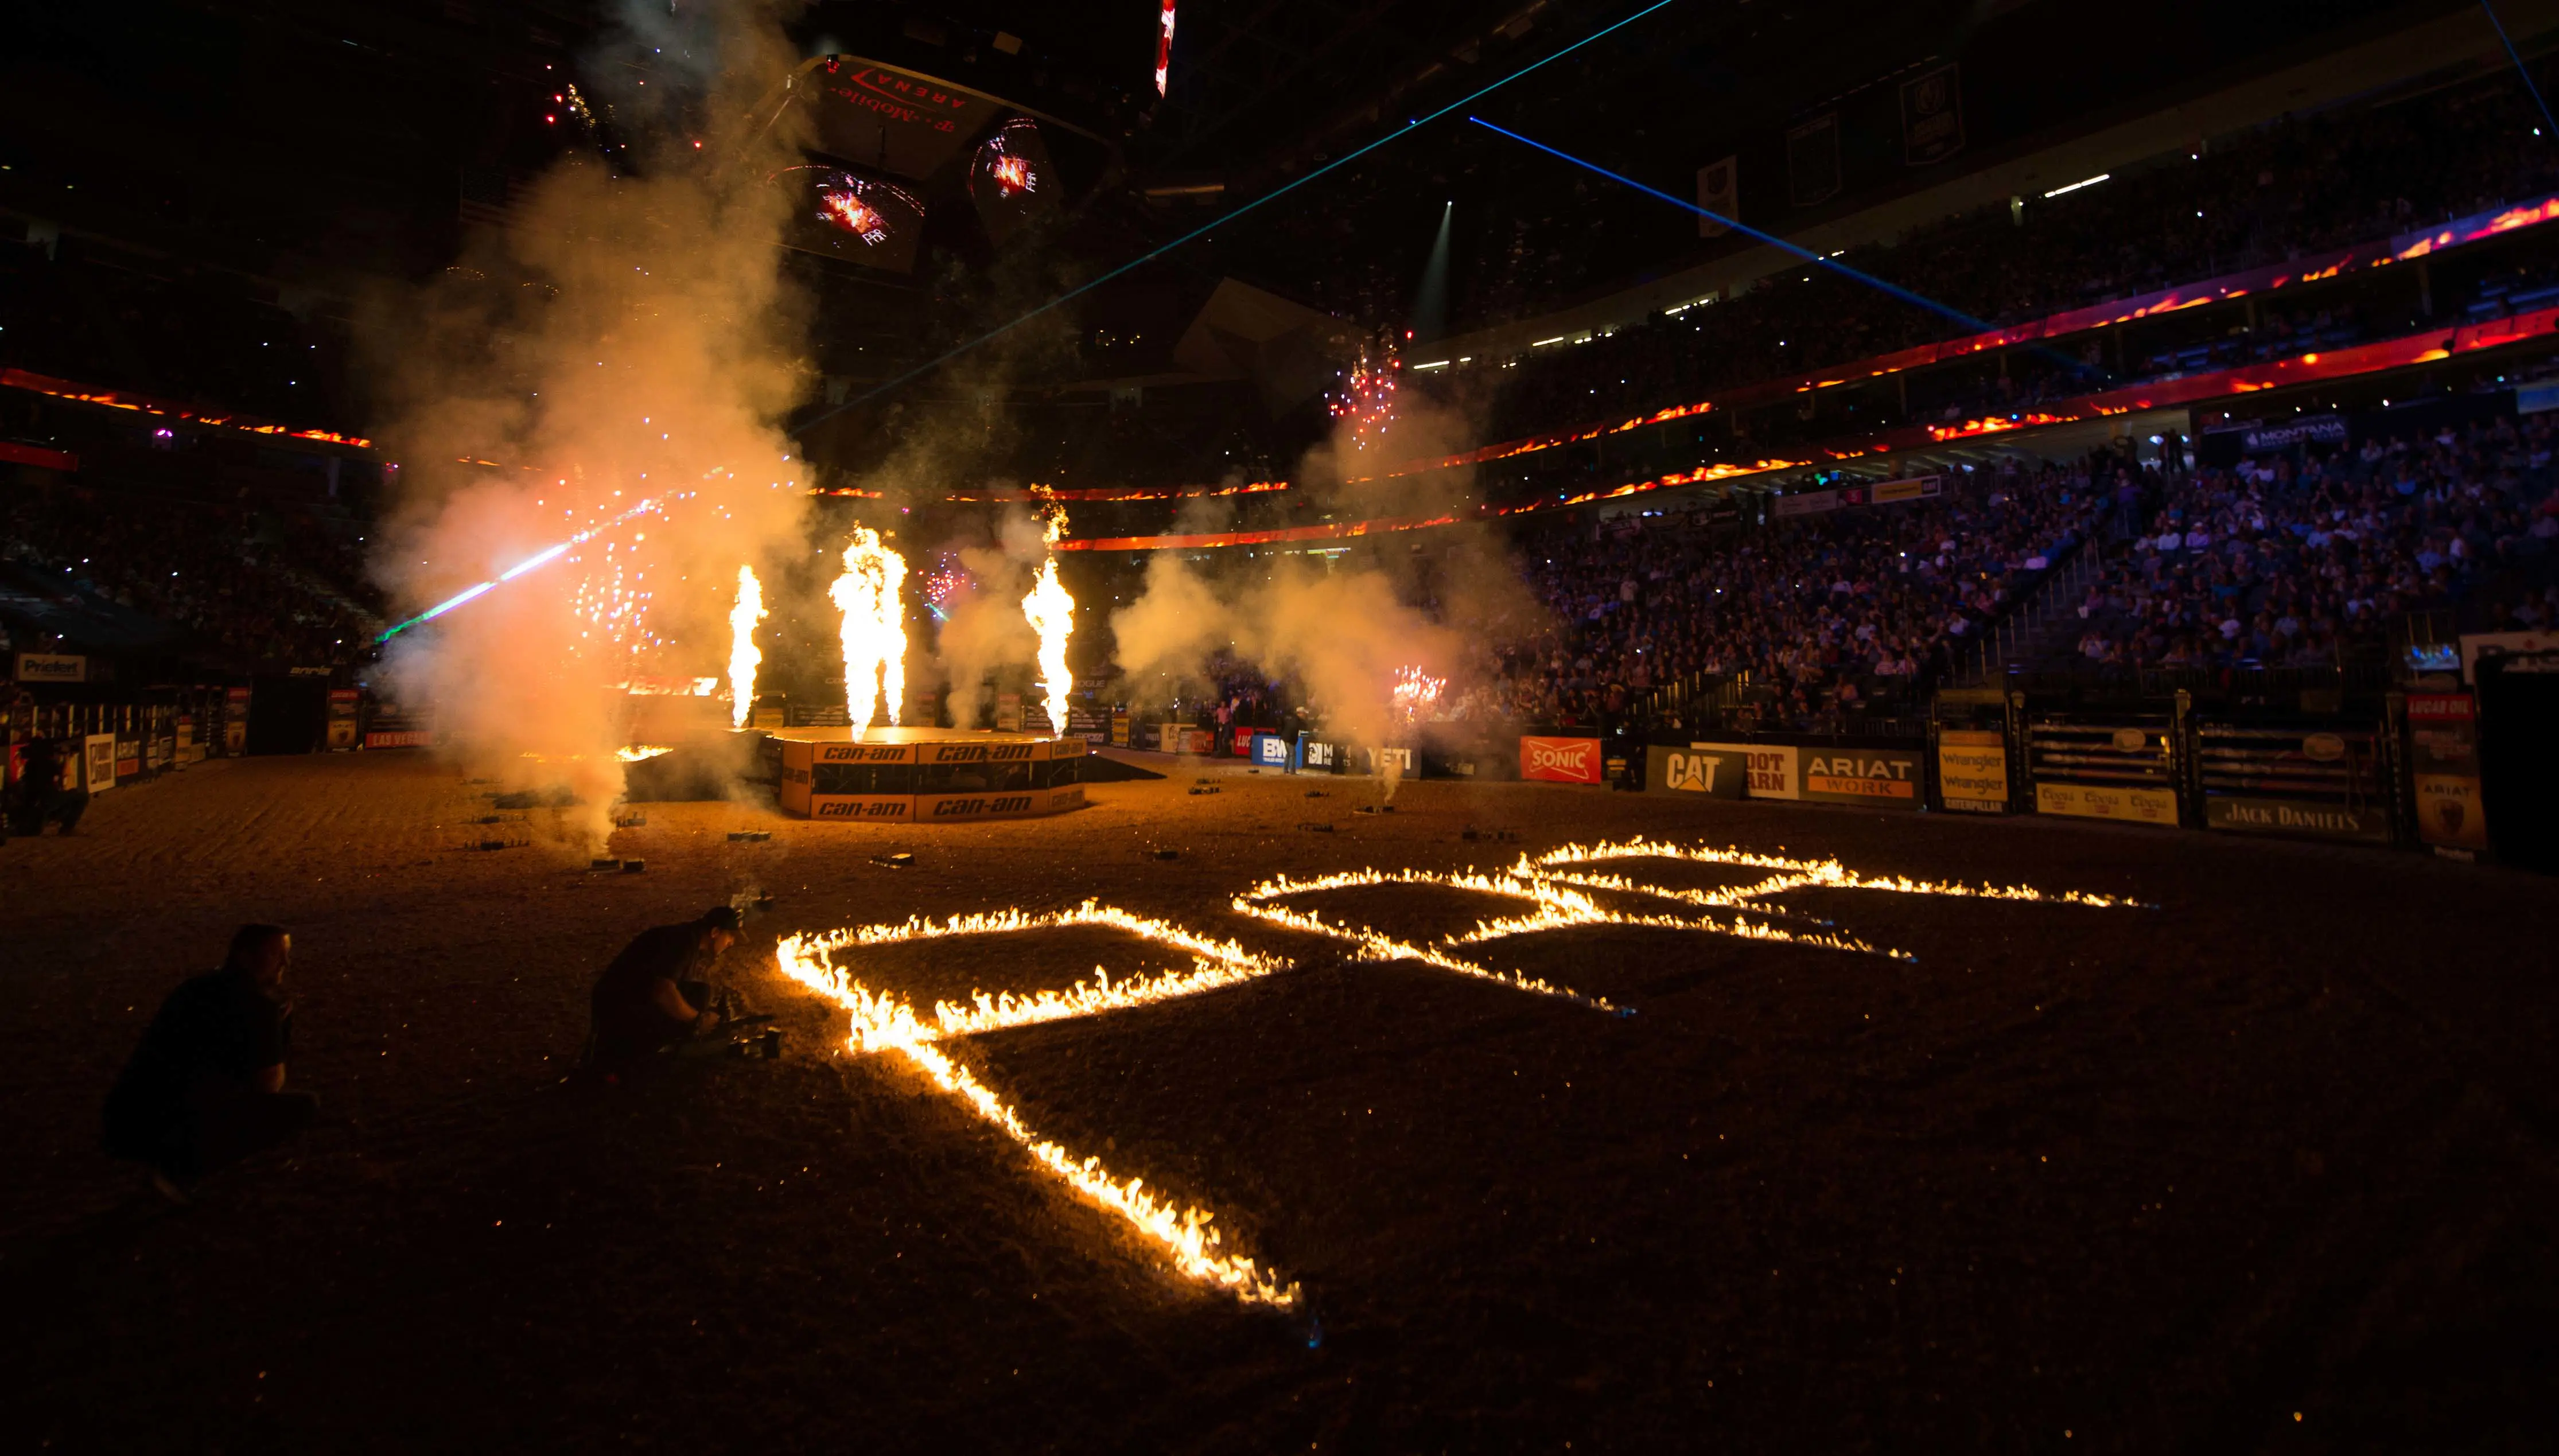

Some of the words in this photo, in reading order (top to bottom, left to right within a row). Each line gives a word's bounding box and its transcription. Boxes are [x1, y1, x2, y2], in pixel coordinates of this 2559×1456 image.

[877, 73, 966, 109] ARENA
[2259, 422, 2344, 441] MONTANA
[372, 734, 391, 746] LAS
[1237, 734, 1251, 748] LUC
[823, 746, 907, 761] can-am
[936, 742, 1035, 762] can-am
[1367, 748, 1411, 770] YETI
[1533, 749, 1586, 769] SONIC
[1746, 752, 1784, 771] OOT
[1807, 756, 1913, 779] ARIAT
[1942, 752, 2004, 772] Wrangler
[1666, 753, 1720, 793] CAT
[1746, 772, 1785, 791] ARN
[1825, 777, 1892, 795] WORK
[1942, 774, 2004, 795] Wrangler
[2424, 784, 2472, 798] ARIAT
[818, 801, 905, 816] can-am
[933, 796, 1032, 815] can-am
[2225, 802, 2273, 824] JACK
